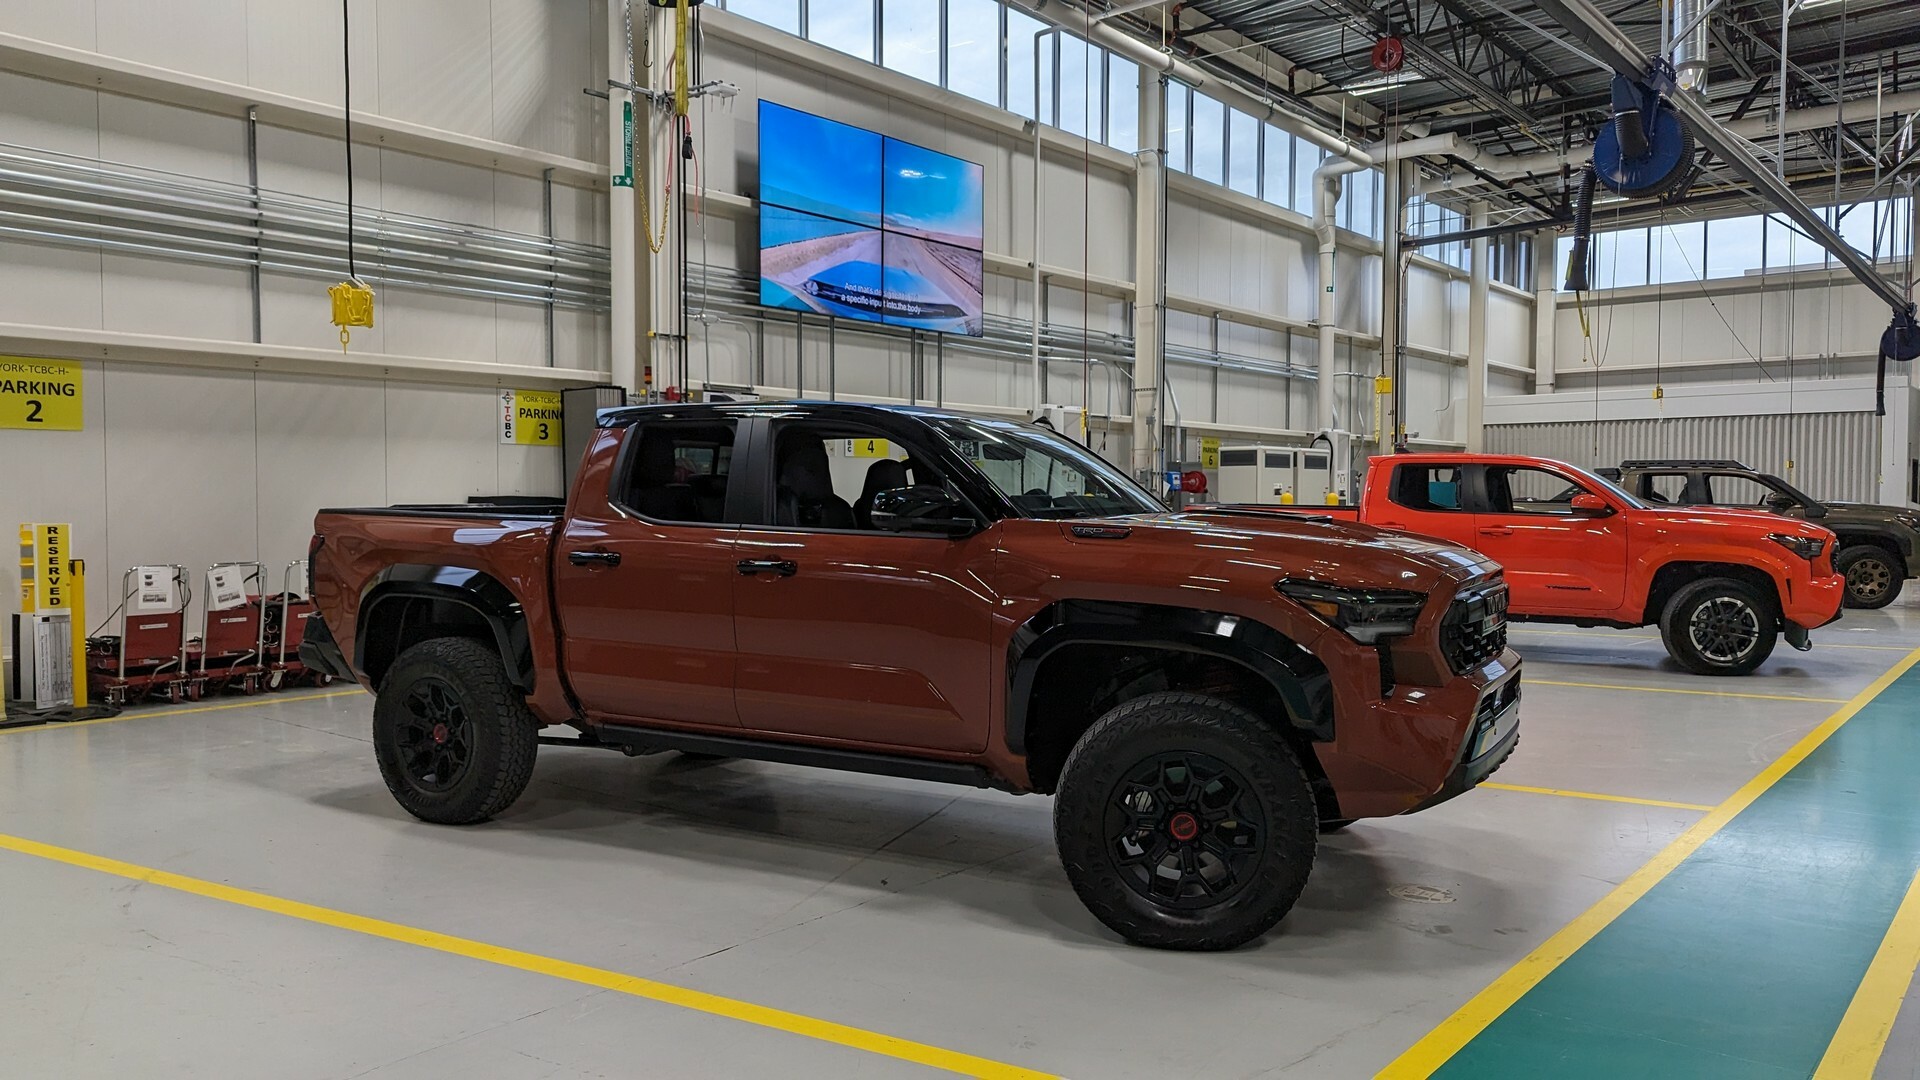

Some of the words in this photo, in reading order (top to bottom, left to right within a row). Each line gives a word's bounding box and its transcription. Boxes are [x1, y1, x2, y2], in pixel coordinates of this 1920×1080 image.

[846, 294, 869, 305] specific
[908, 304, 920, 315] body
[0, 379, 75, 397] ARKING
[26, 400, 43, 423] 2
[519, 407, 562, 420] PARKIN
[538, 423, 549, 441] 3
[867, 440, 875, 454] 4
[1209, 455, 1213, 465] 6
[47, 526, 61, 606] RESERVED
